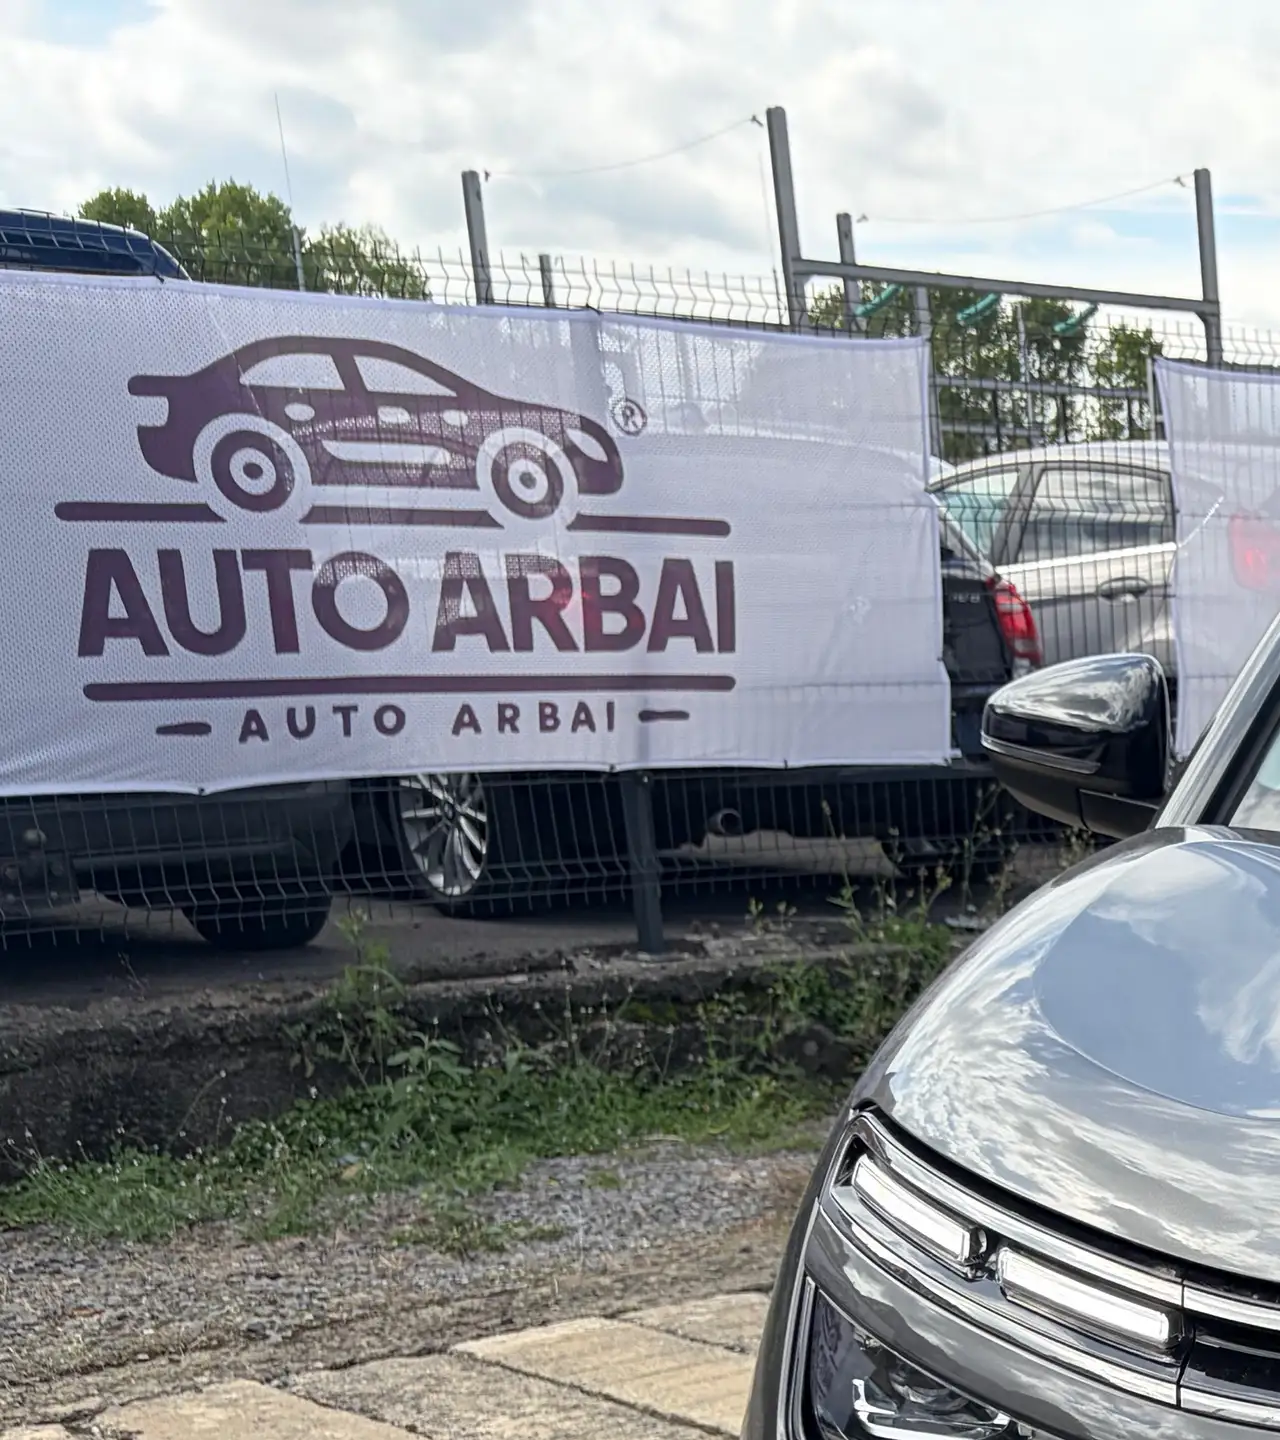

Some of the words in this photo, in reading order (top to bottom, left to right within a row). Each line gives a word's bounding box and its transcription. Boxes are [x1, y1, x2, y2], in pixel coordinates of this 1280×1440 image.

[78, 548, 410, 657] AUTO
[431, 550, 736, 653] ARBAI
[238, 704, 407, 743] AUTO
[450, 702, 616, 736] ARBAI
